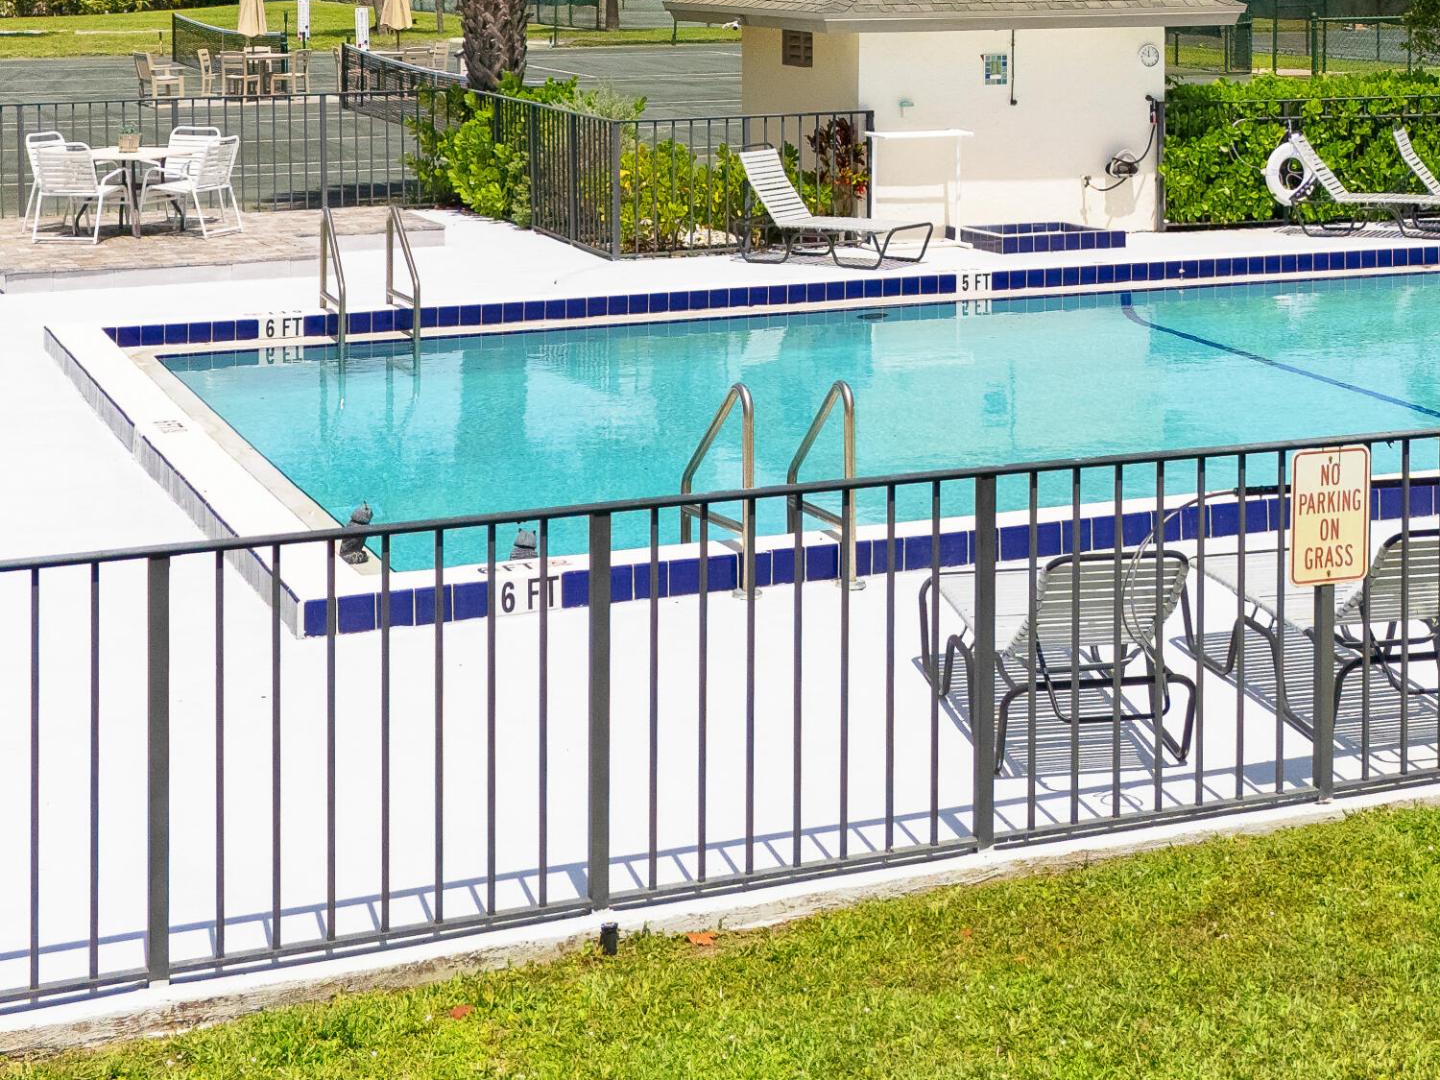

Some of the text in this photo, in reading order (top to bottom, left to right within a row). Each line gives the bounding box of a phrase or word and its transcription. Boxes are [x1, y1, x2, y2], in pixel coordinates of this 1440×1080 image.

[962, 273, 991, 291] 5 FT
[266, 317, 303, 338] 6 FT
[1321, 463, 1341, 486] NO
[1298, 488, 1361, 516] PARKING
[1320, 517, 1340, 541] ON
[1304, 543, 1354, 570] GRASS
[501, 575, 559, 614] 6 FT
